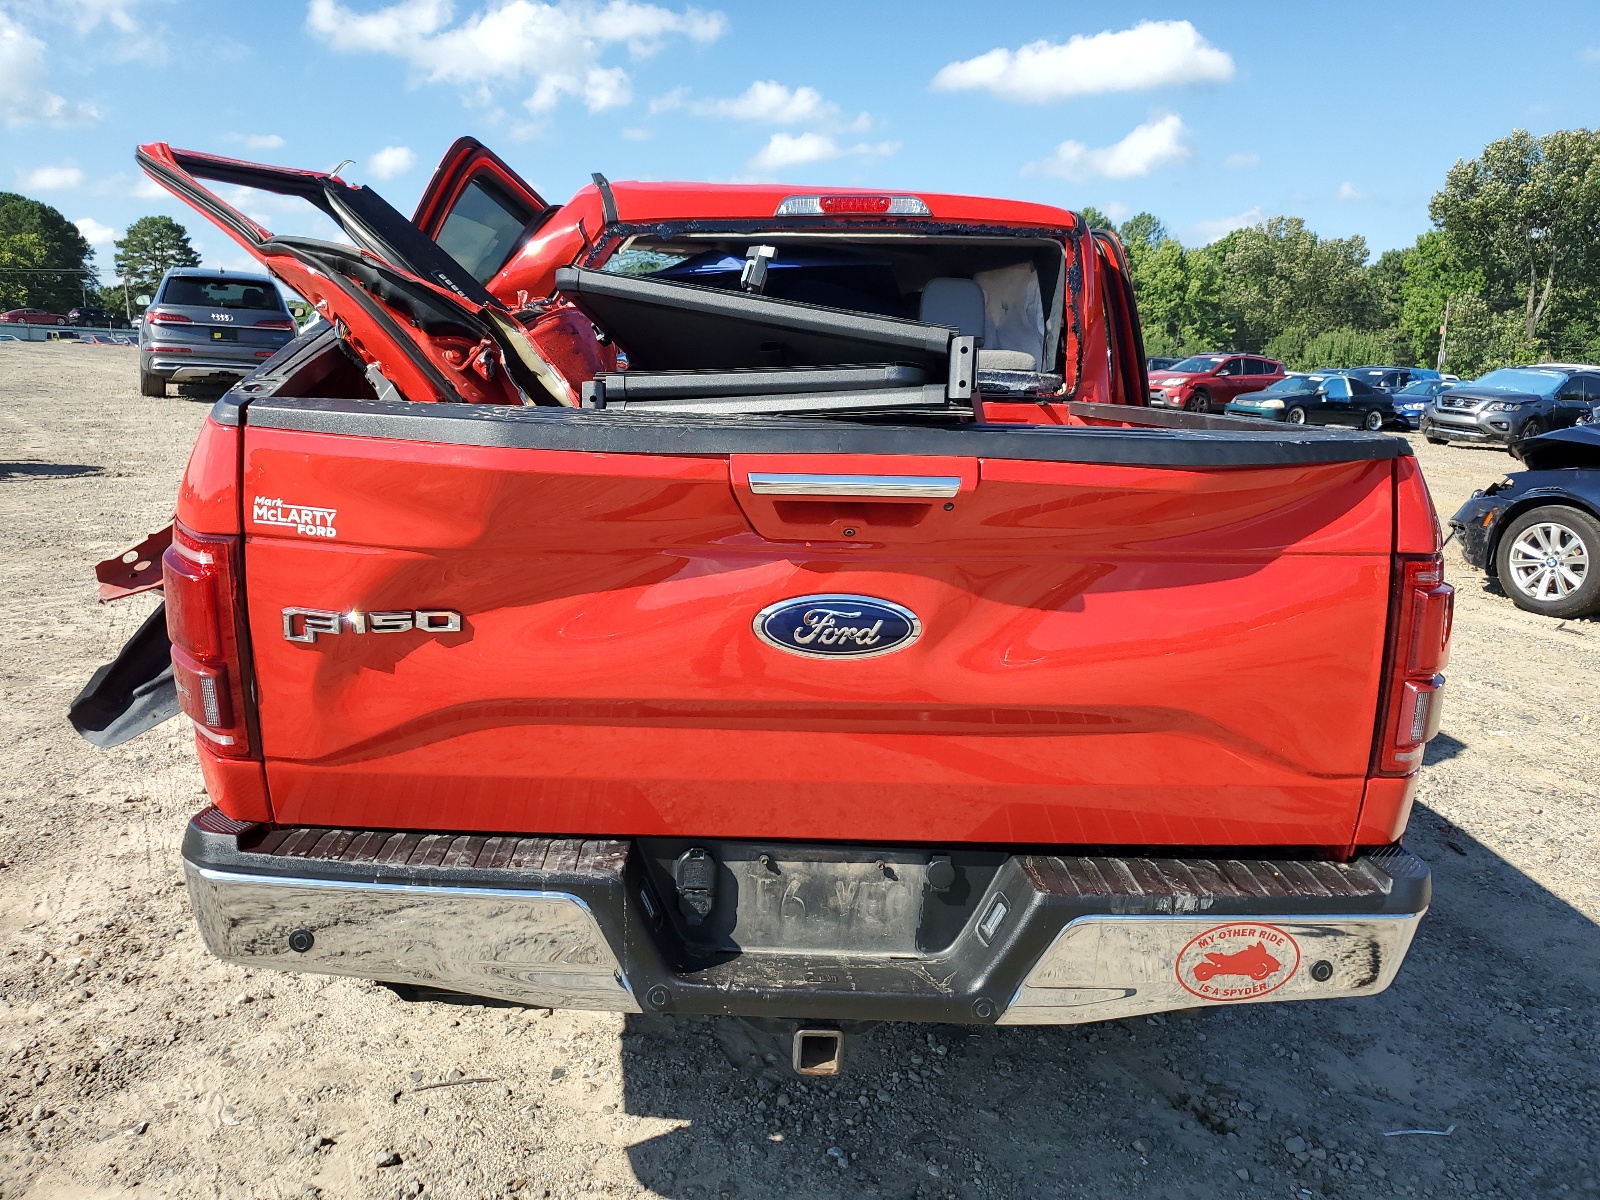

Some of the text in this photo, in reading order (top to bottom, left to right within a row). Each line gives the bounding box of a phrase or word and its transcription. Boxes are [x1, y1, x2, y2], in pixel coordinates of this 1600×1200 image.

[254, 495, 284, 508] Mark
[253, 505, 337, 527] McLARTY
[297, 523, 337, 538] FORD
[793, 608, 883, 645] Ford
[1198, 928, 1285, 948] MY OTHER RIDE
[1198, 982, 1267, 997] IS A SPYDER
